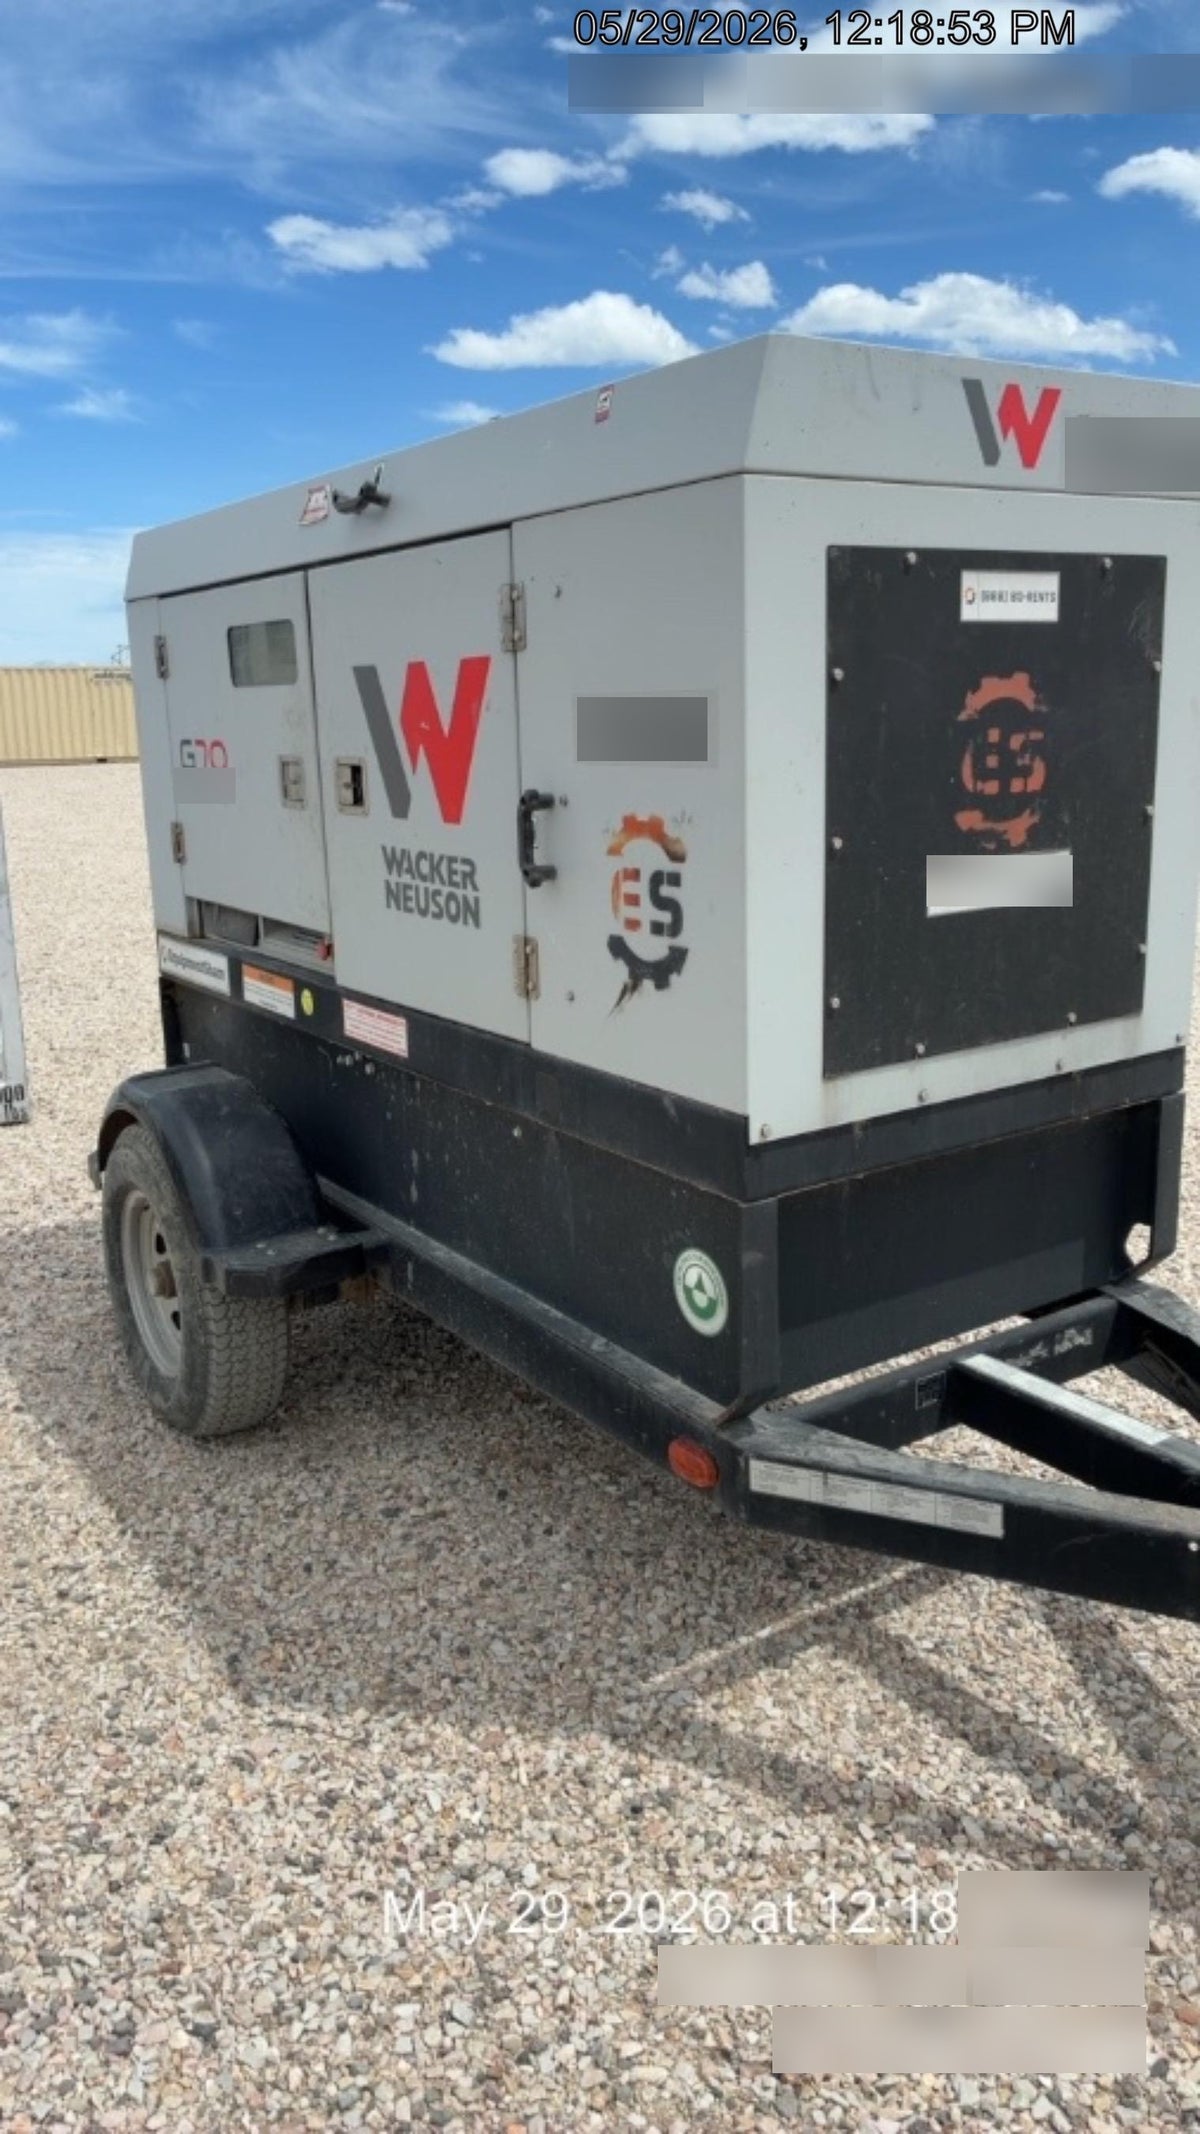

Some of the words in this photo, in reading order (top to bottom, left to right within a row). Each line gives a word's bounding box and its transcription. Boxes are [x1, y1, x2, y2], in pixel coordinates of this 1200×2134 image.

[179, 738, 229, 769] G70
[381, 844, 480, 892] WACKER
[384, 878, 481, 930] NEUSON
